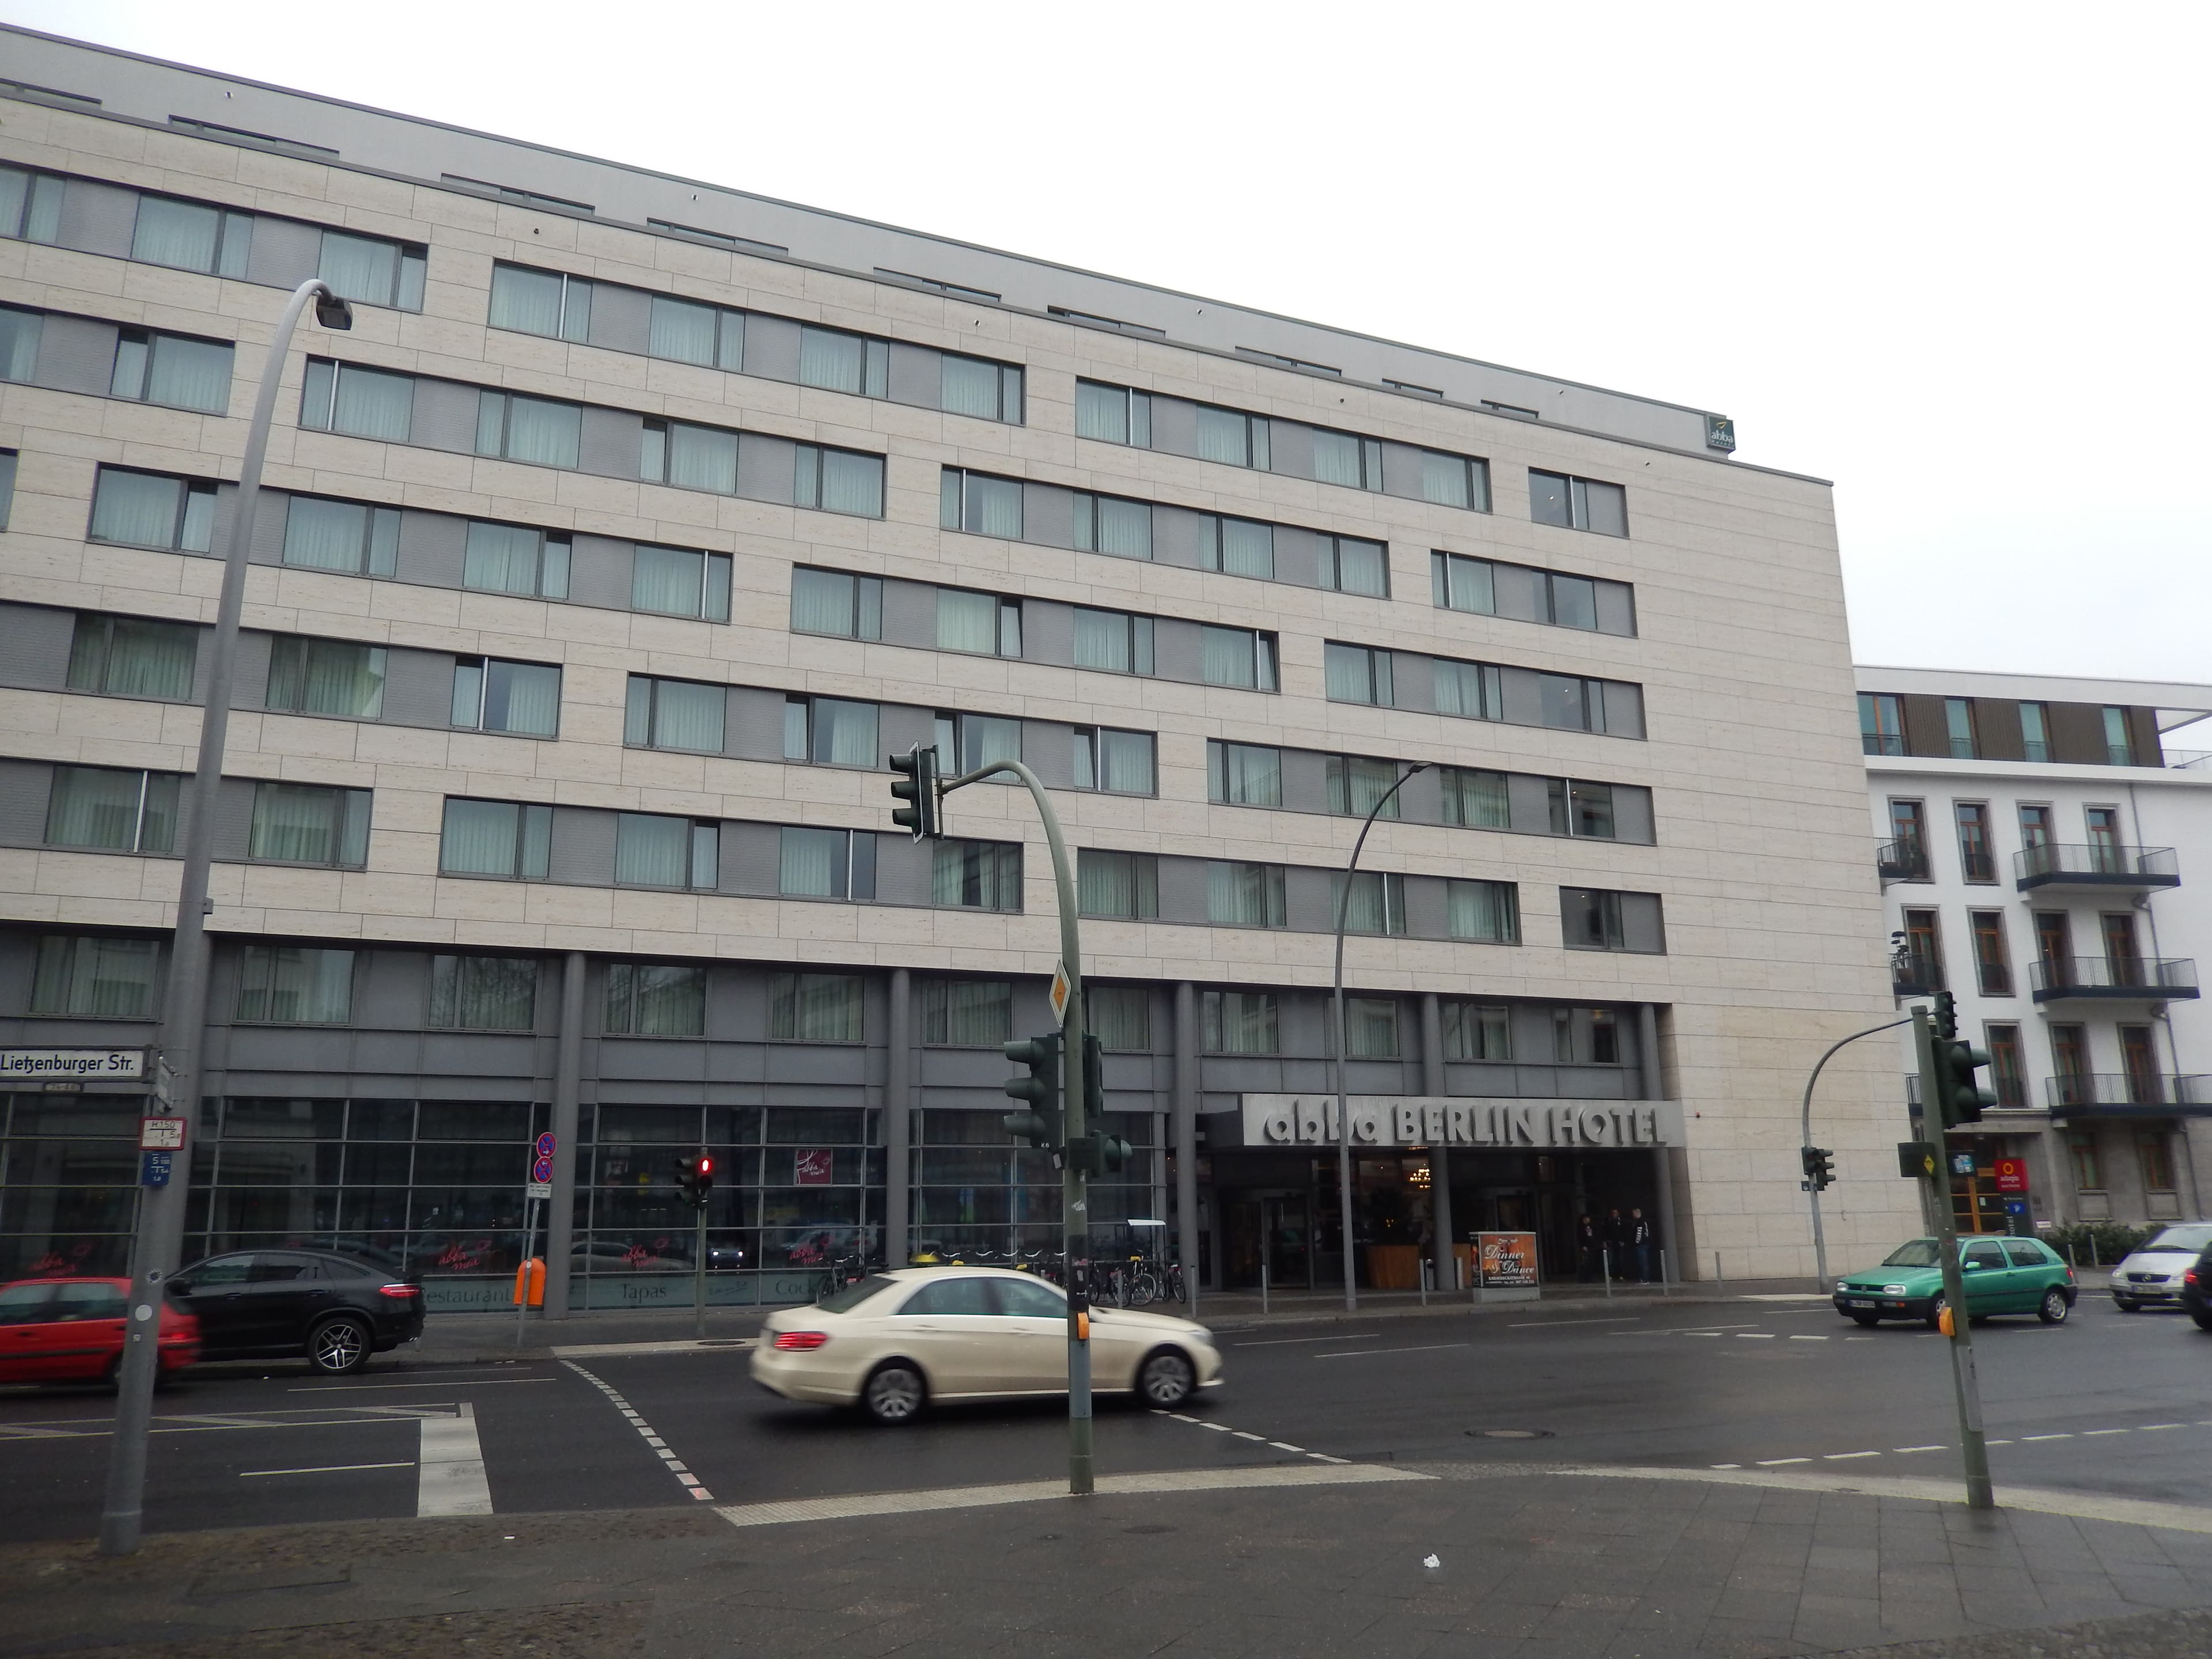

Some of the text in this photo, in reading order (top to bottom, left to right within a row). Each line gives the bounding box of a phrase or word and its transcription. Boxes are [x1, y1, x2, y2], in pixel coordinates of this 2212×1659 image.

[1711, 430, 1733, 443] abba
[1, 1054, 134, 1074] Lietzenburger Str.
[1391, 1103, 1537, 1143] BERLIN
[1548, 1106, 1667, 1145] HOTEL
[1484, 1244, 1525, 1259] Dinner
[1502, 1260, 1535, 1274] Dance
[423, 1286, 514, 1305] estaurant
[621, 1283, 667, 1304] Tapas
